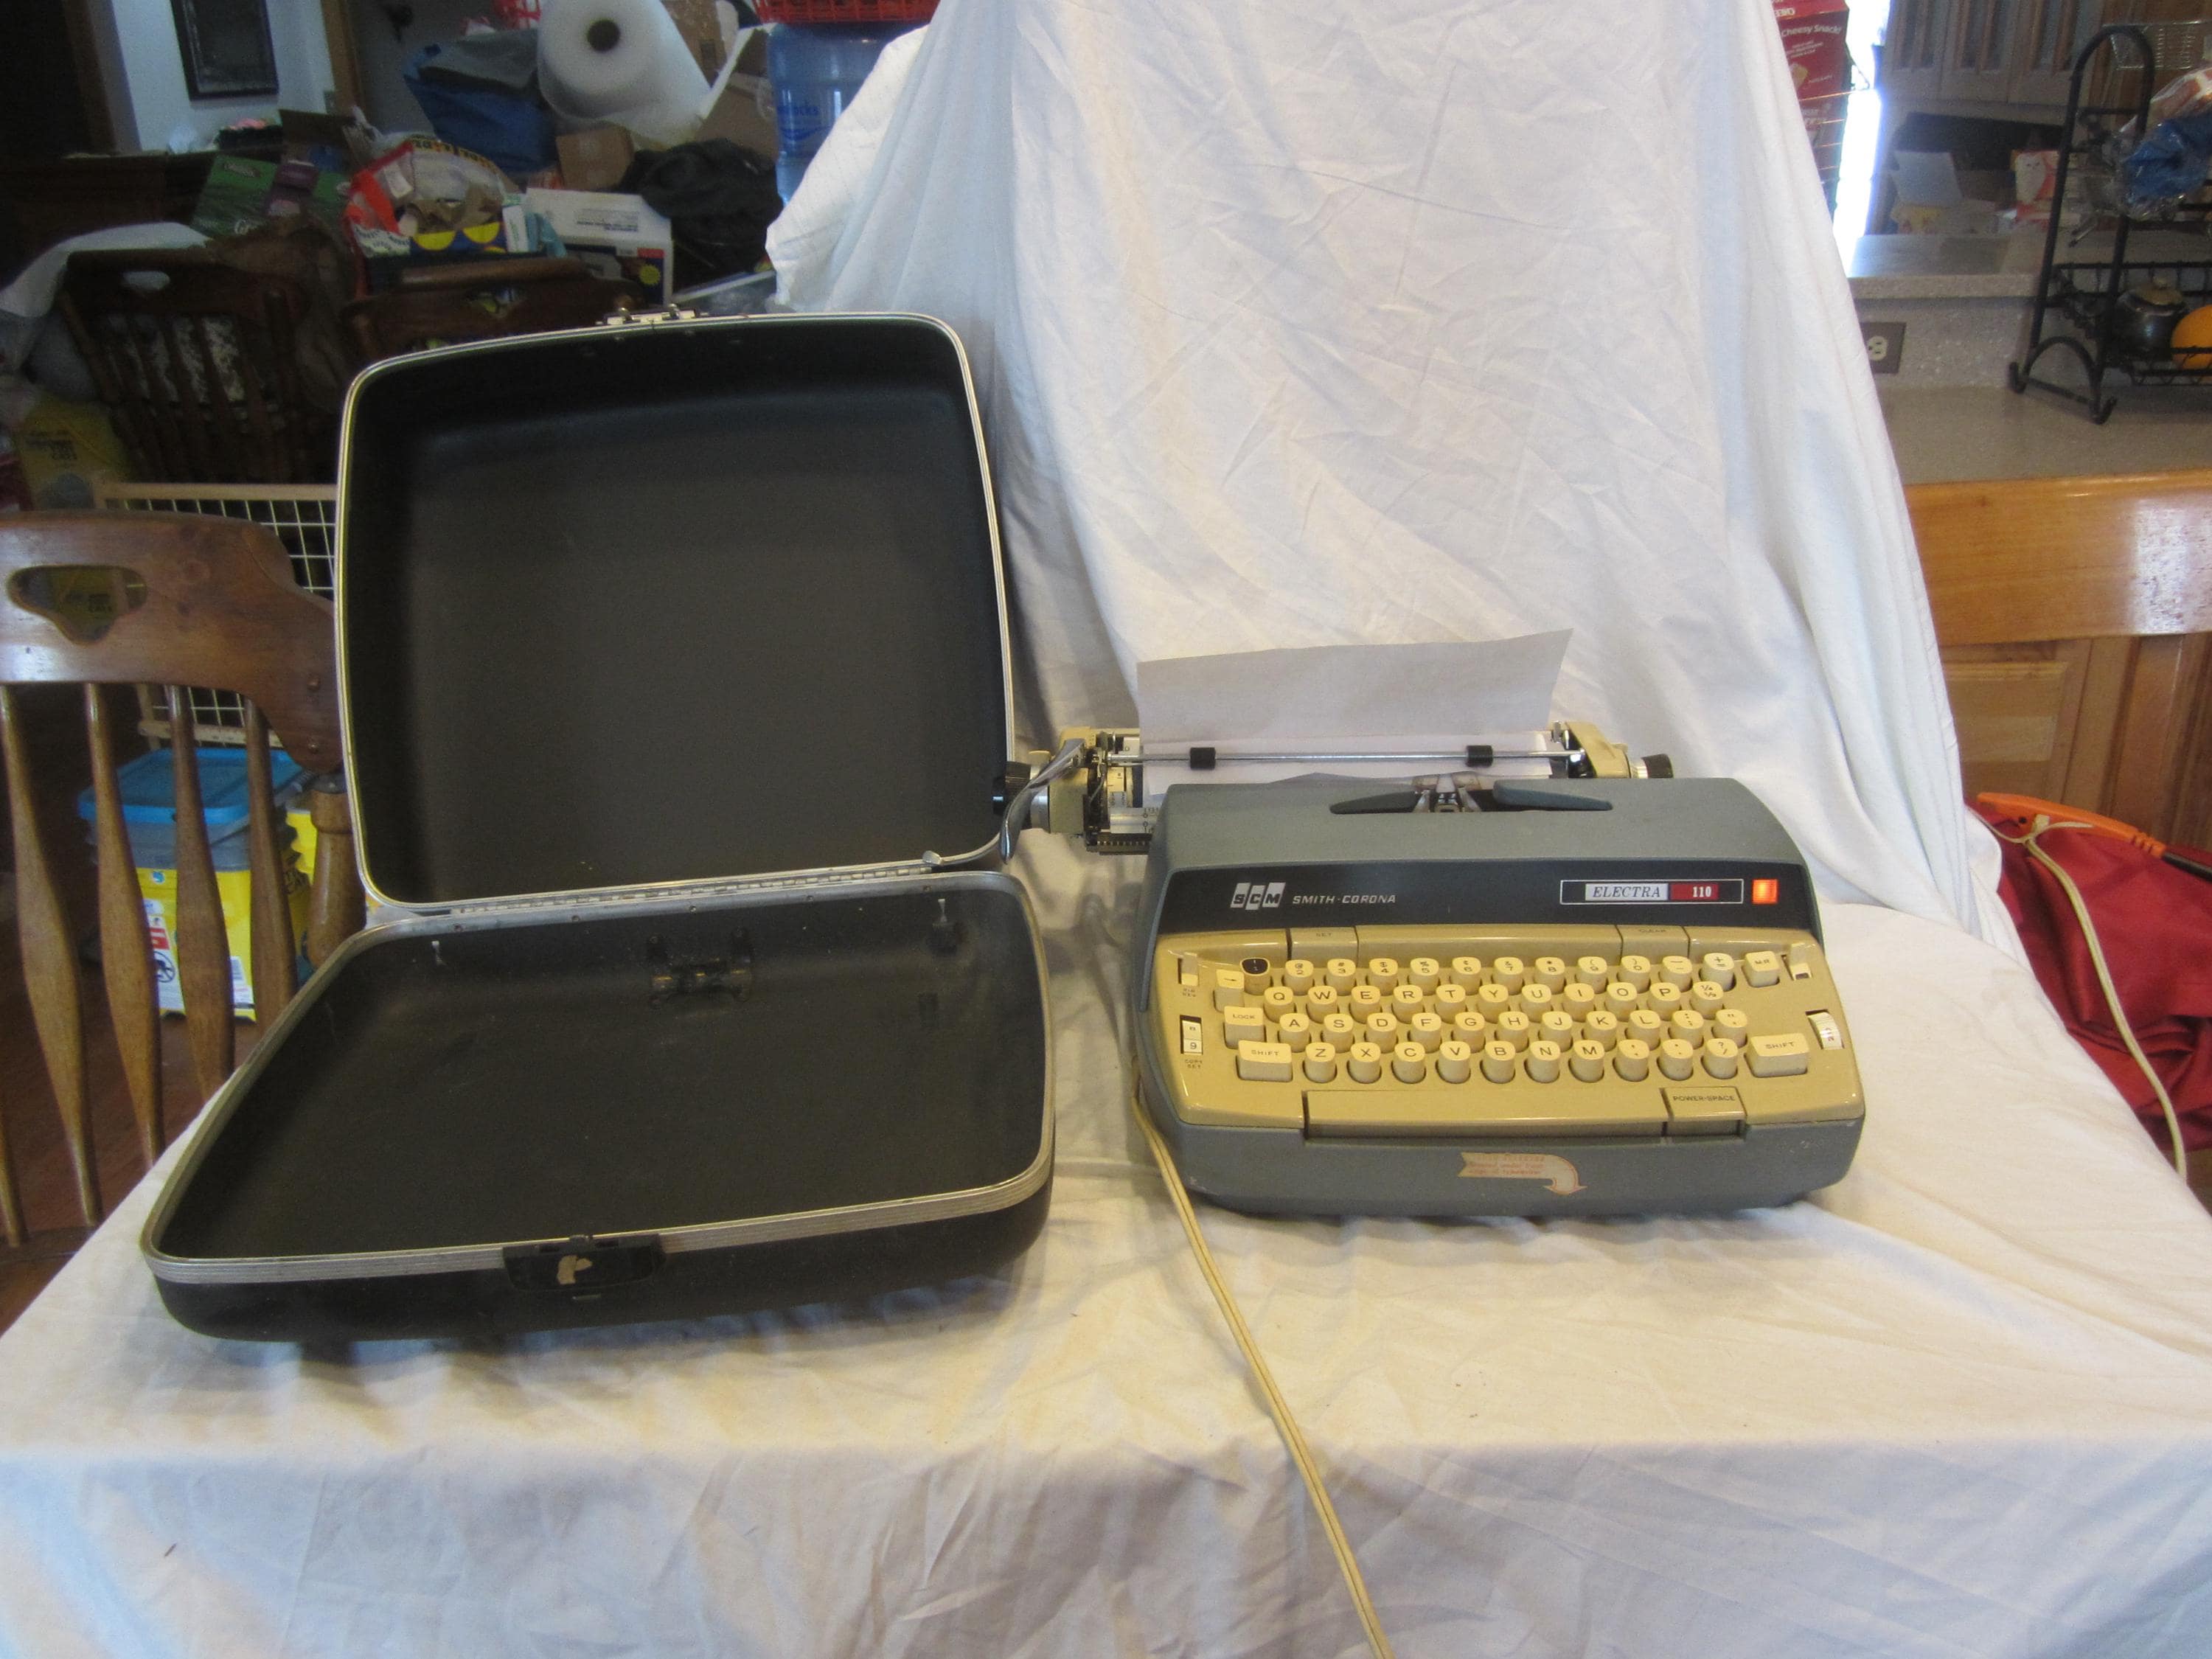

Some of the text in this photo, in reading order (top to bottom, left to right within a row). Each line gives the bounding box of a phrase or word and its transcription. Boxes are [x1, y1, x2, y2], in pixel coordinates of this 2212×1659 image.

[1592, 886, 1712, 898] ELECTRA 110
[1273, 992, 1285, 1001] Q
[1313, 990, 1331, 1001] W
[1360, 991, 1373, 1000] E
[1402, 990, 1415, 999] R
[1444, 990, 1456, 998] T
[1489, 990, 1499, 998] Y
[1531, 990, 1543, 998] U
[1616, 988, 1629, 997] O
[1659, 988, 1671, 996] P
[1289, 1018, 1301, 1027] A
[1333, 1020, 1345, 1029] S
[1376, 1018, 1388, 1027] D
[1420, 1018, 1432, 1027] F
[1464, 1018, 1476, 1026] G
[1508, 1017, 1521, 1026] H
[1554, 1017, 1562, 1026] J
[1596, 1016, 1609, 1026] K
[1638, 1015, 1652, 1025] L
[1189, 1041, 1197, 1050] 9
[1765, 1041, 1795, 1049] SHIFT
[1315, 1048, 1326, 1057] Z
[1360, 1048, 1372, 1057] X
[1404, 1048, 1416, 1057] C
[1450, 1047, 1461, 1056] V
[1494, 1047, 1507, 1056] B
[1540, 1047, 1552, 1056] N
[1582, 1046, 1598, 1055] M
